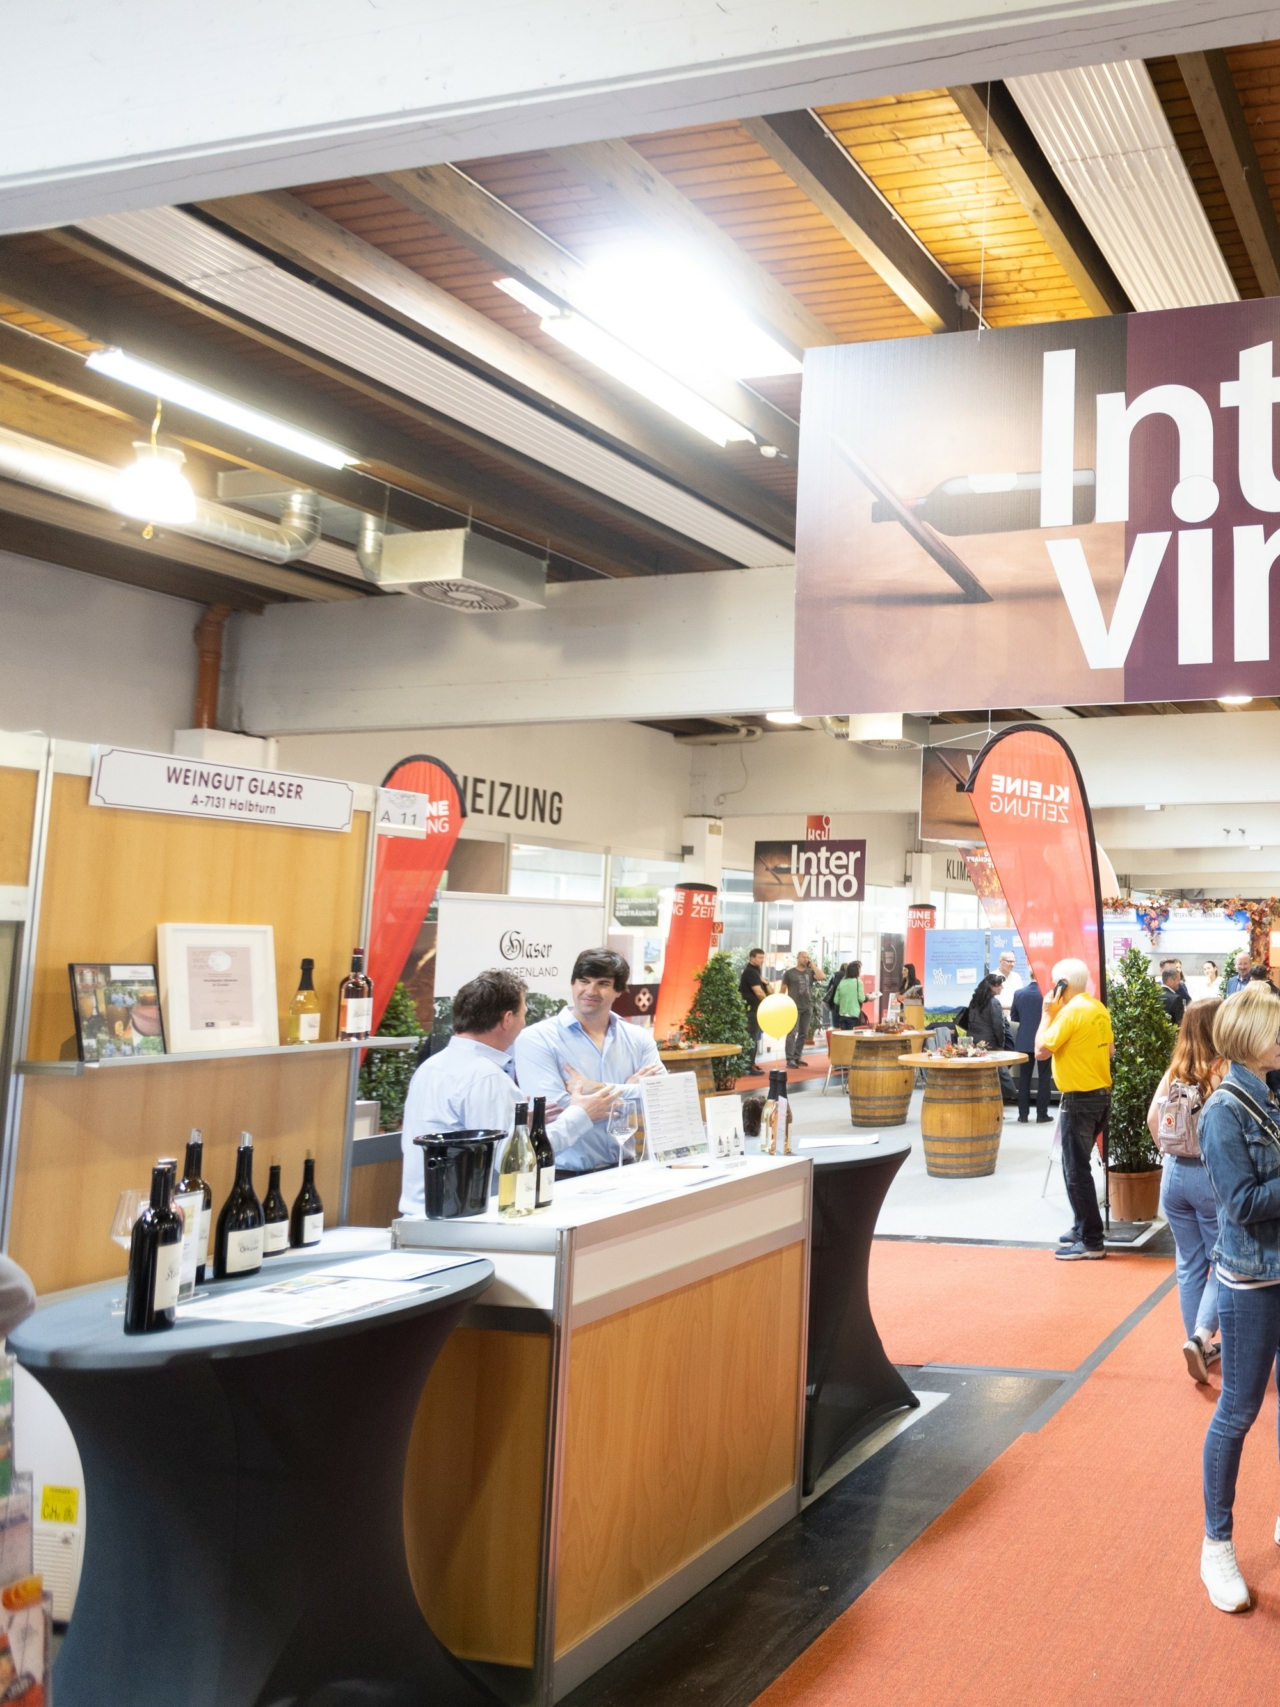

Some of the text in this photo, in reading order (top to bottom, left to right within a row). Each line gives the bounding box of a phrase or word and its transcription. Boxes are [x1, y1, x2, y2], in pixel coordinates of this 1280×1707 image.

[166, 765, 304, 801] WEINGUT GLASER
[190, 794, 277, 815] A-7131 Halbturn
[380, 811, 418, 825] A 11
[790, 844, 861, 876] Inter
[791, 868, 858, 898] vino
[499, 930, 552, 961] Glaser
